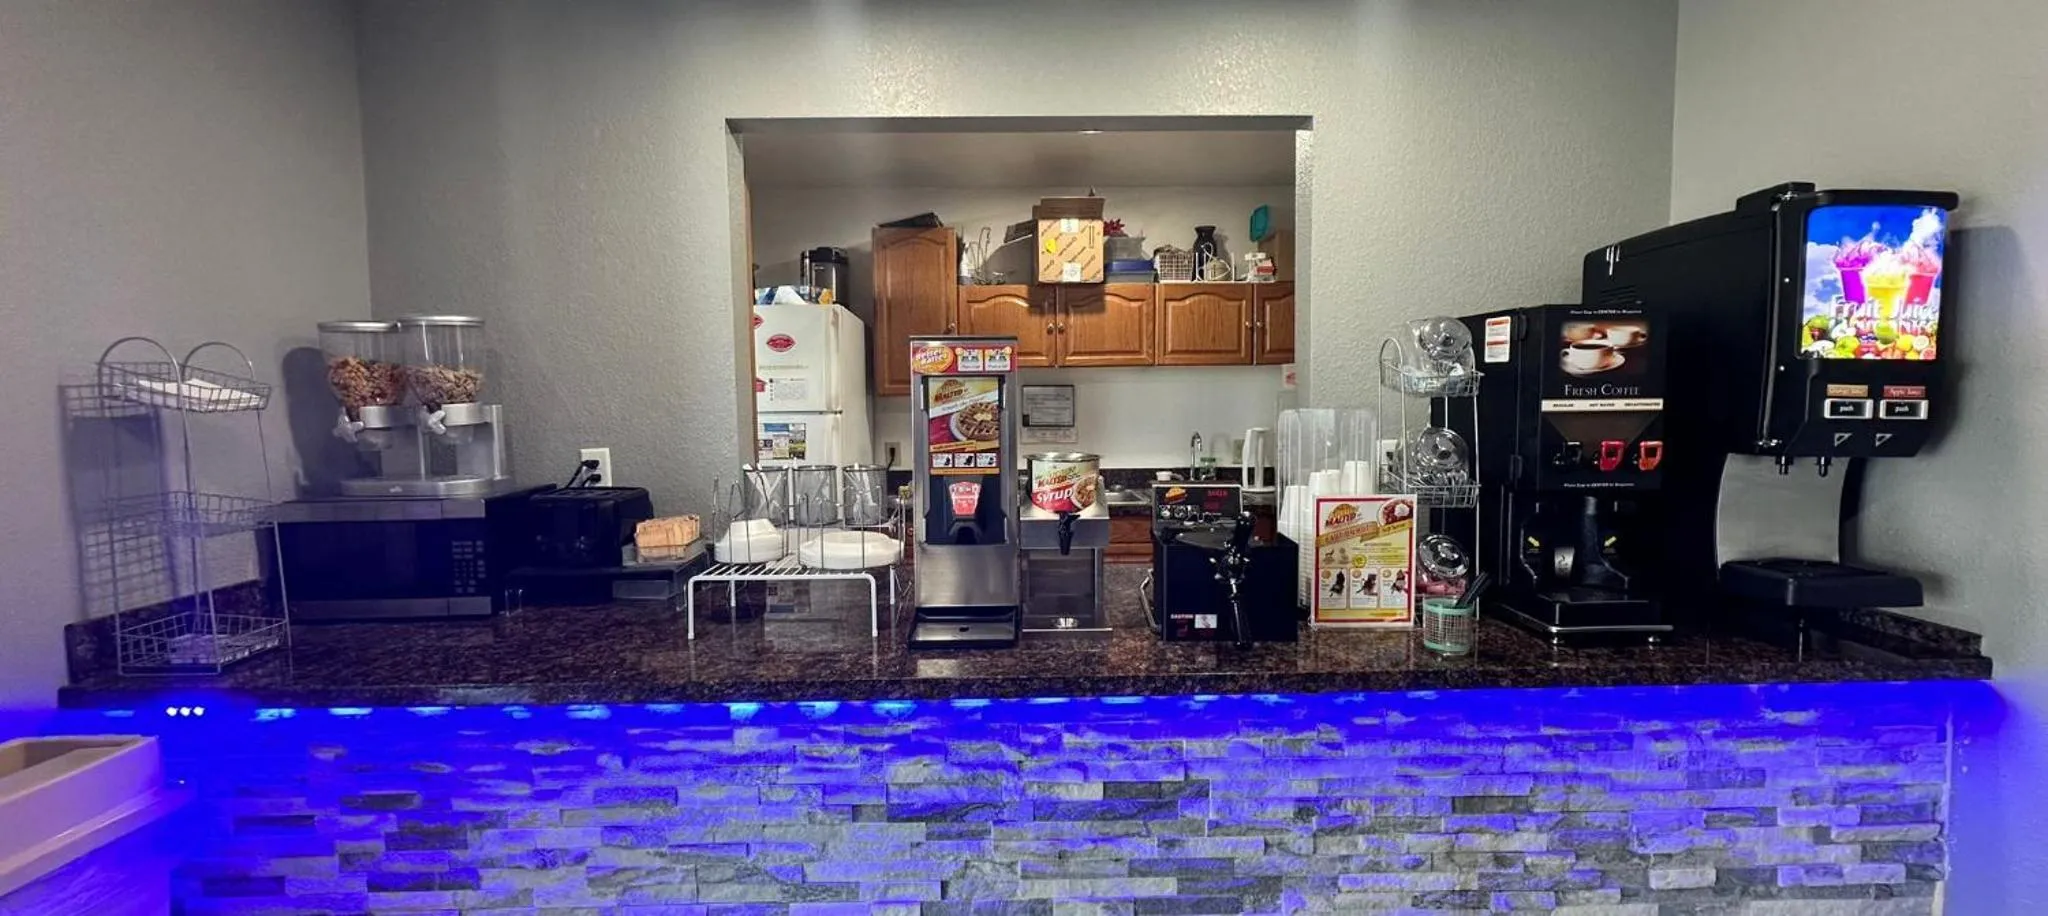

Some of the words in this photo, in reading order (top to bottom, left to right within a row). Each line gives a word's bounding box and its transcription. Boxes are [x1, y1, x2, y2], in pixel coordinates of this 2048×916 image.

[1830, 295, 1879, 318] Fruit
[1889, 297, 1938, 319] Juice
[1564, 384, 1597, 396] FRESH
[1601, 383, 1640, 395] COFFEE
[1839, 405, 1854, 413] push
[1895, 405, 1910, 413] push
[1036, 488, 1073, 503] Syrup
